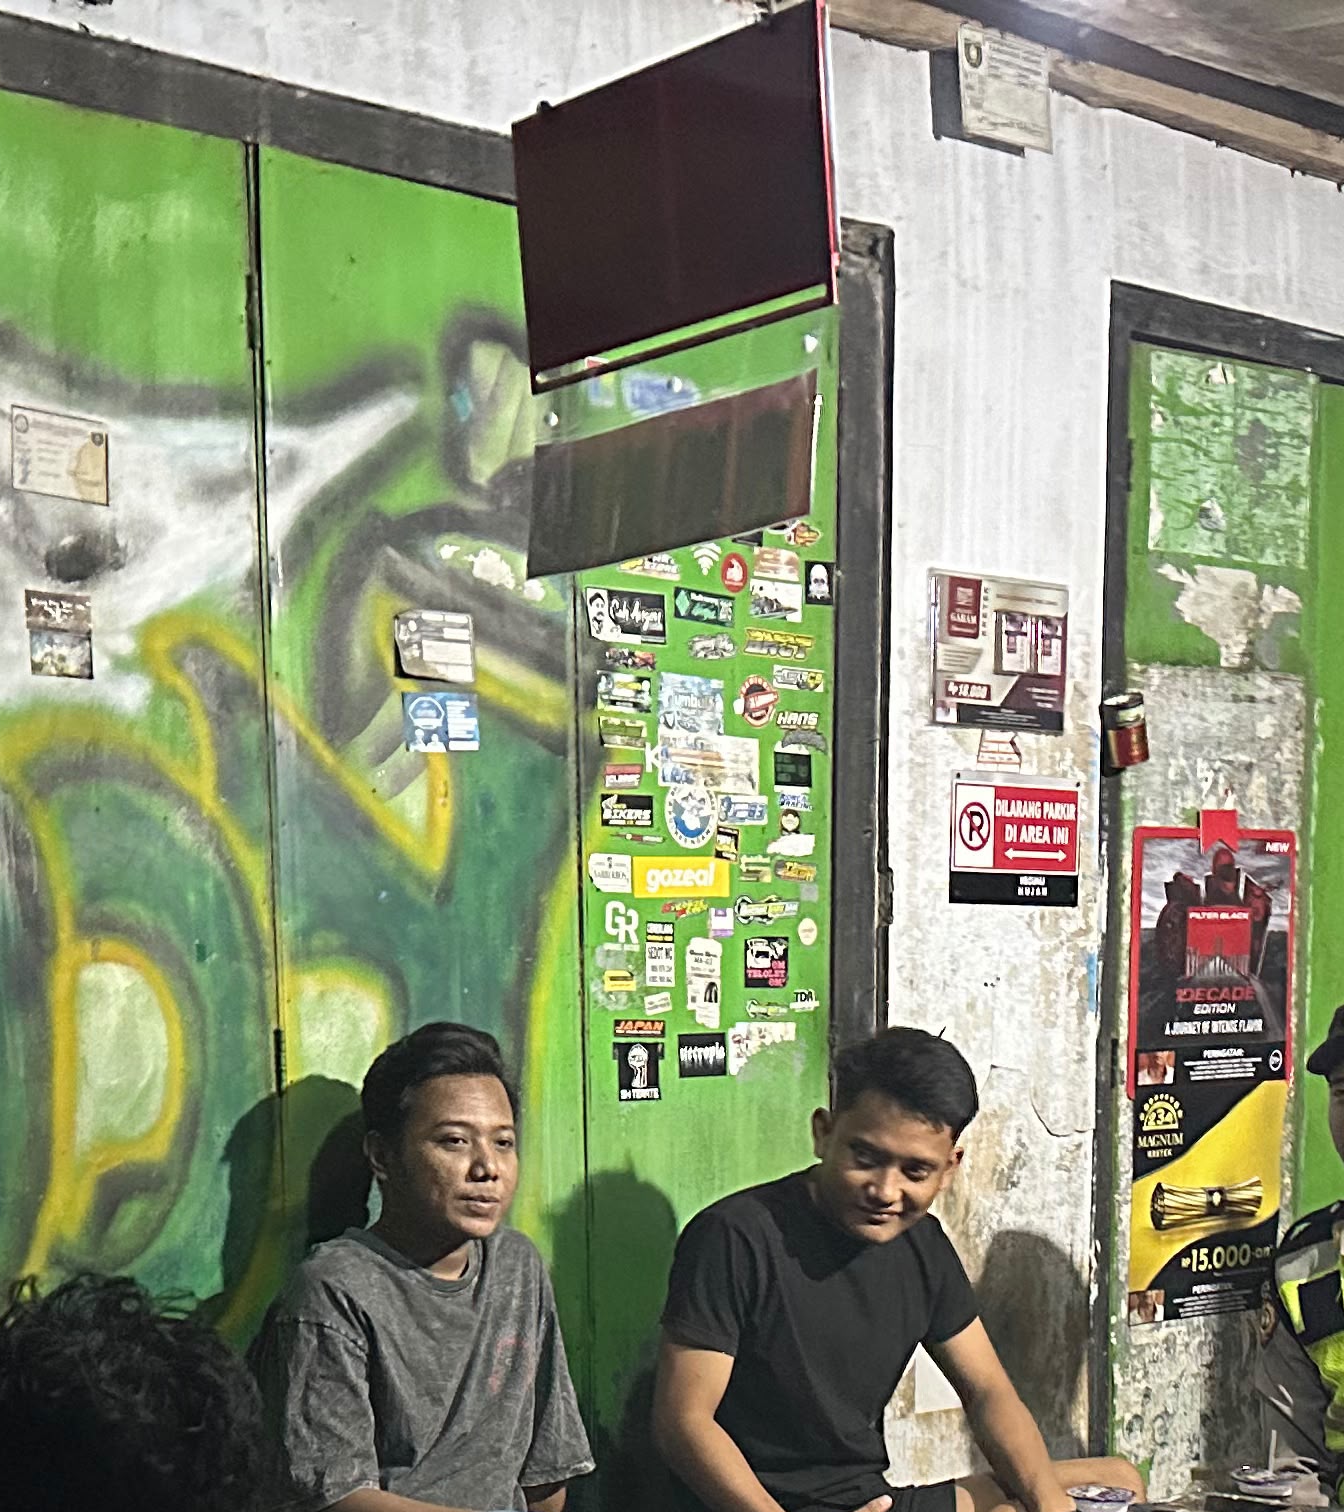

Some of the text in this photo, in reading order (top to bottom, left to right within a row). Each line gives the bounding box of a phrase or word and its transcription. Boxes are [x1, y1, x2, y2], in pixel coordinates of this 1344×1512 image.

[995, 799, 1076, 821] DILARANG PARKIR
[1005, 824, 1069, 845] DI AREA INI
[1265, 841, 1290, 853] NEW
[646, 861, 715, 893] gozeal
[1193, 1003, 1236, 1014] EDITION
[614, 1020, 664, 1031] JAPAN
[1137, 1132, 1184, 1149] MAGNUM
